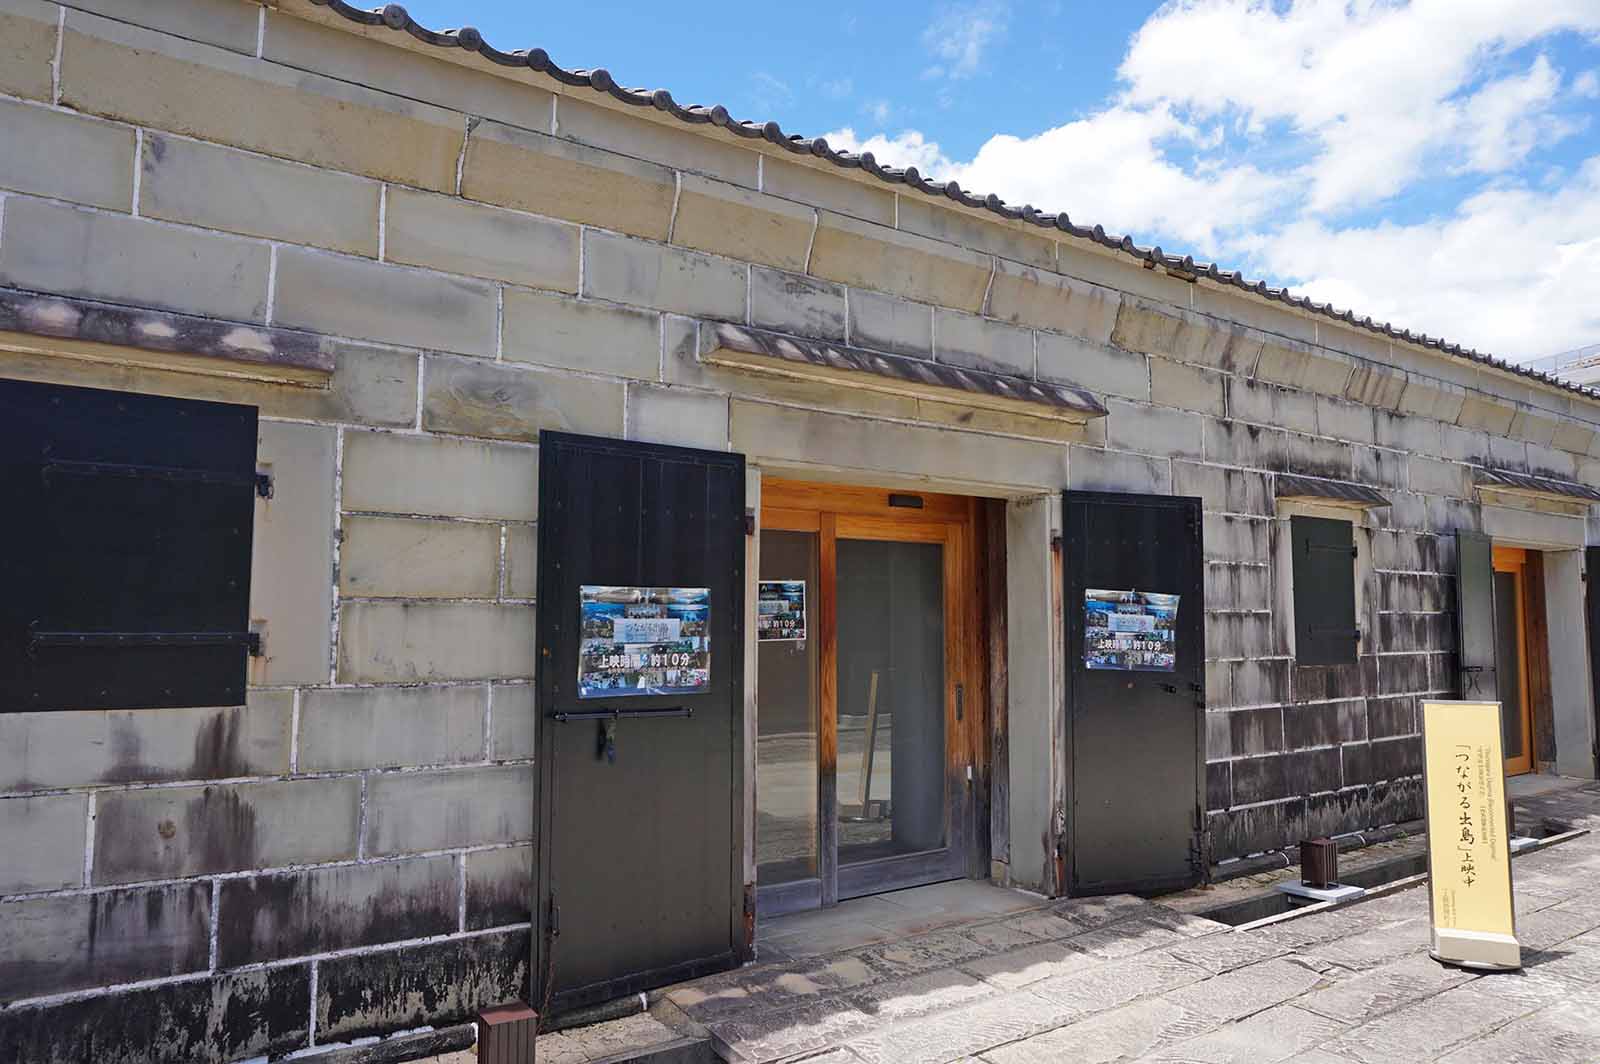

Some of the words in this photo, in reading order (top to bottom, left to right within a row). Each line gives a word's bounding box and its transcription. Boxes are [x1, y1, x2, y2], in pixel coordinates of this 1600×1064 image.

[1455, 744, 1476, 888] 「つながる出島」上映中
